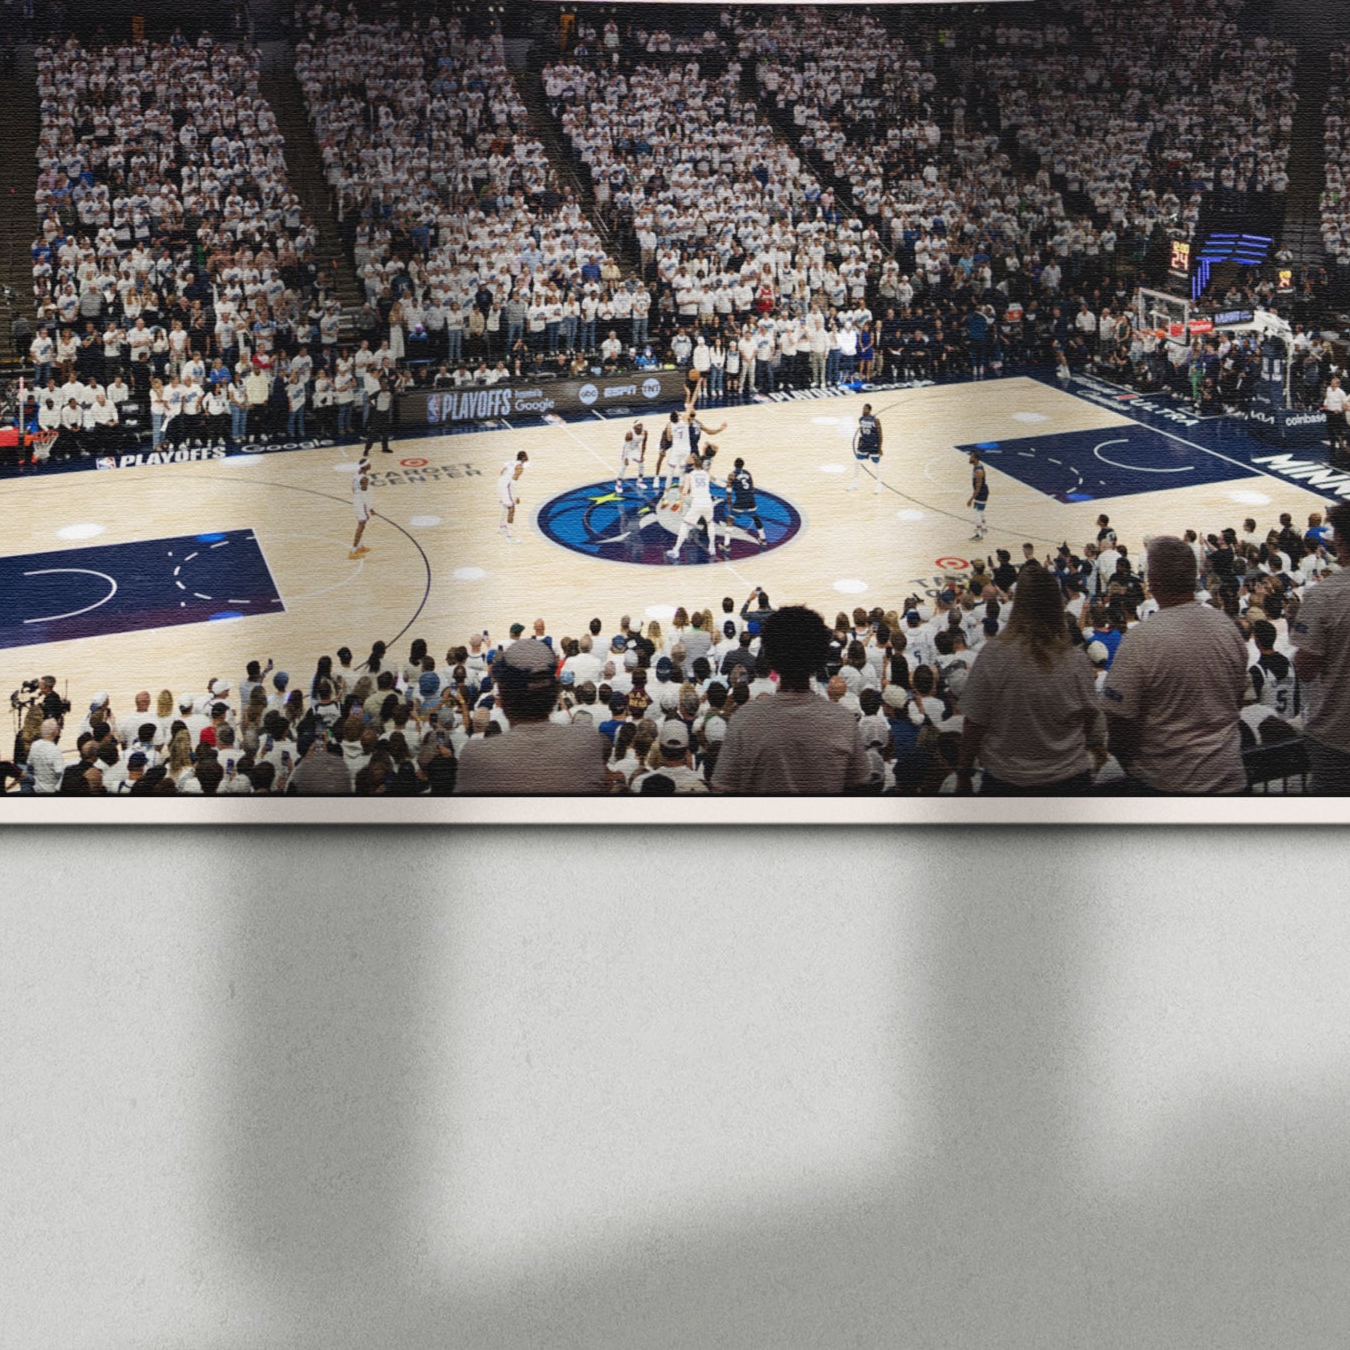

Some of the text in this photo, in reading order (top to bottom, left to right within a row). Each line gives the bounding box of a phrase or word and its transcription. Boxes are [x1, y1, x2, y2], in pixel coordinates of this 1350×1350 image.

[1171, 251, 1189, 271] 24
[604, 385, 637, 398] ESPN
[441, 388, 512, 421] PLAYOFFS
[514, 398, 555, 412] Google
[1130, 399, 1200, 426] ULTRA
[1285, 413, 1328, 426] coinbase
[119, 438, 336, 468] PLAYOFFS Google
[369, 463, 474, 480] TARGET
[370, 470, 482, 487] CENTER
[741, 478, 750, 490] 5
[1275, 689, 1288, 713] 5
